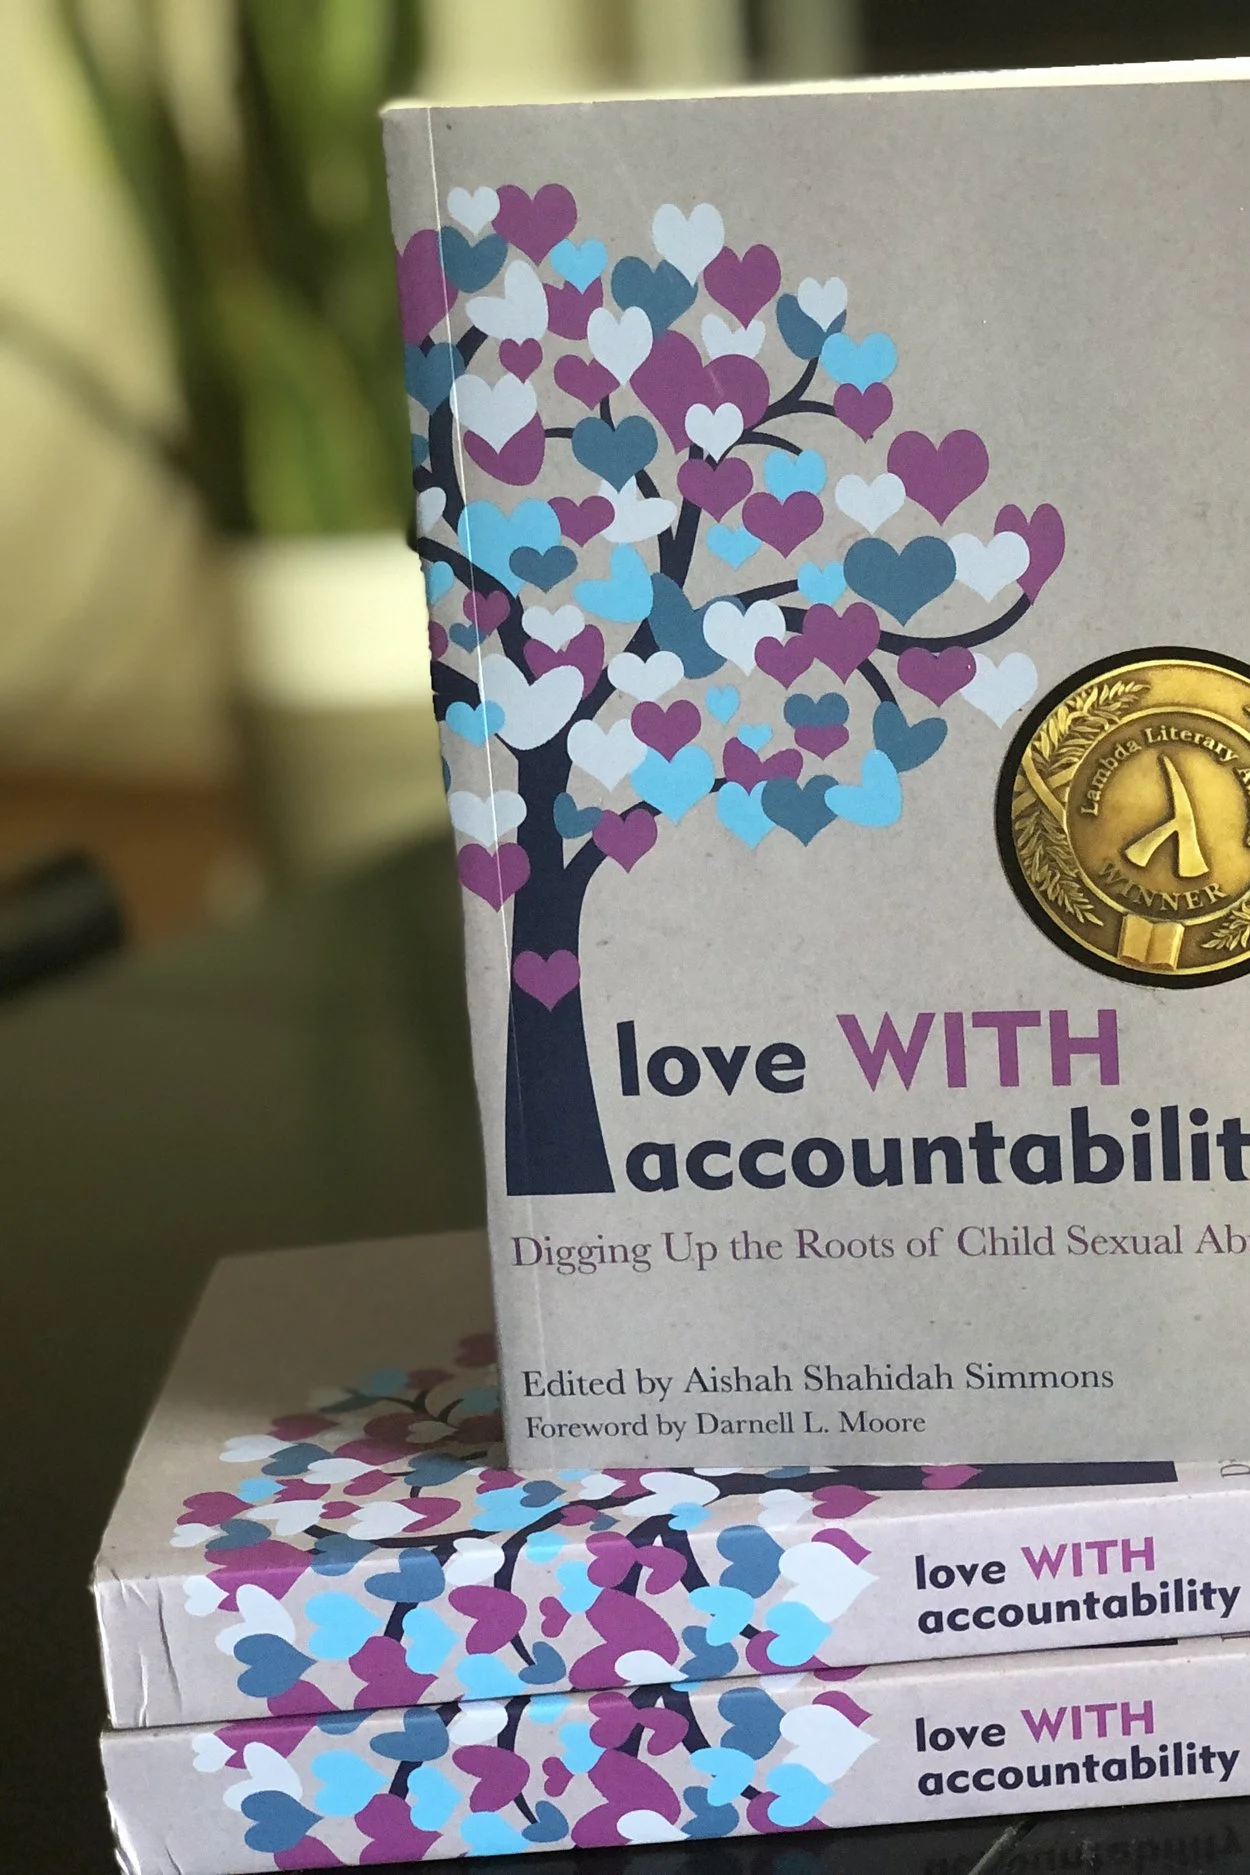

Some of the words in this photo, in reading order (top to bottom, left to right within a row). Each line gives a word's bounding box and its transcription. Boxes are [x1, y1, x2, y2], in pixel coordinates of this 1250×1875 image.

[1081, 738, 1142, 817] Lambda
[1145, 725, 1239, 762] Literary
[1099, 859, 1228, 911] WINNER
[617, 1020, 806, 1097] love
[836, 1009, 1119, 1092] WITH
[512, 1235, 651, 1275] Digging
[662, 1232, 717, 1271] Up
[730, 1231, 782, 1260] the
[796, 1229, 894, 1258] Roots
[907, 1227, 944, 1257] of
[958, 1226, 1055, 1256] Child
[1068, 1225, 1182, 1255] Sexual
[522, 1369, 625, 1396] Edited
[636, 1368, 672, 1402] by
[684, 1365, 792, 1392] Aishah
[804, 1364, 953, 1391] Shahidah
[966, 1363, 1113, 1389] Simmons
[526, 1414, 648, 1438] Foreword
[656, 1414, 686, 1441] by
[697, 1412, 794, 1434] Darnell
[805, 1412, 828, 1432] L.
[839, 1411, 925, 1432] Moore
[915, 1555, 1005, 1589] love
[1021, 1537, 1154, 1580] WITH
[917, 1578, 1241, 1634] accountability
[916, 1717, 1005, 1752] love
[1021, 1700, 1153, 1743] WITH
[917, 1741, 1240, 1796] accountability
